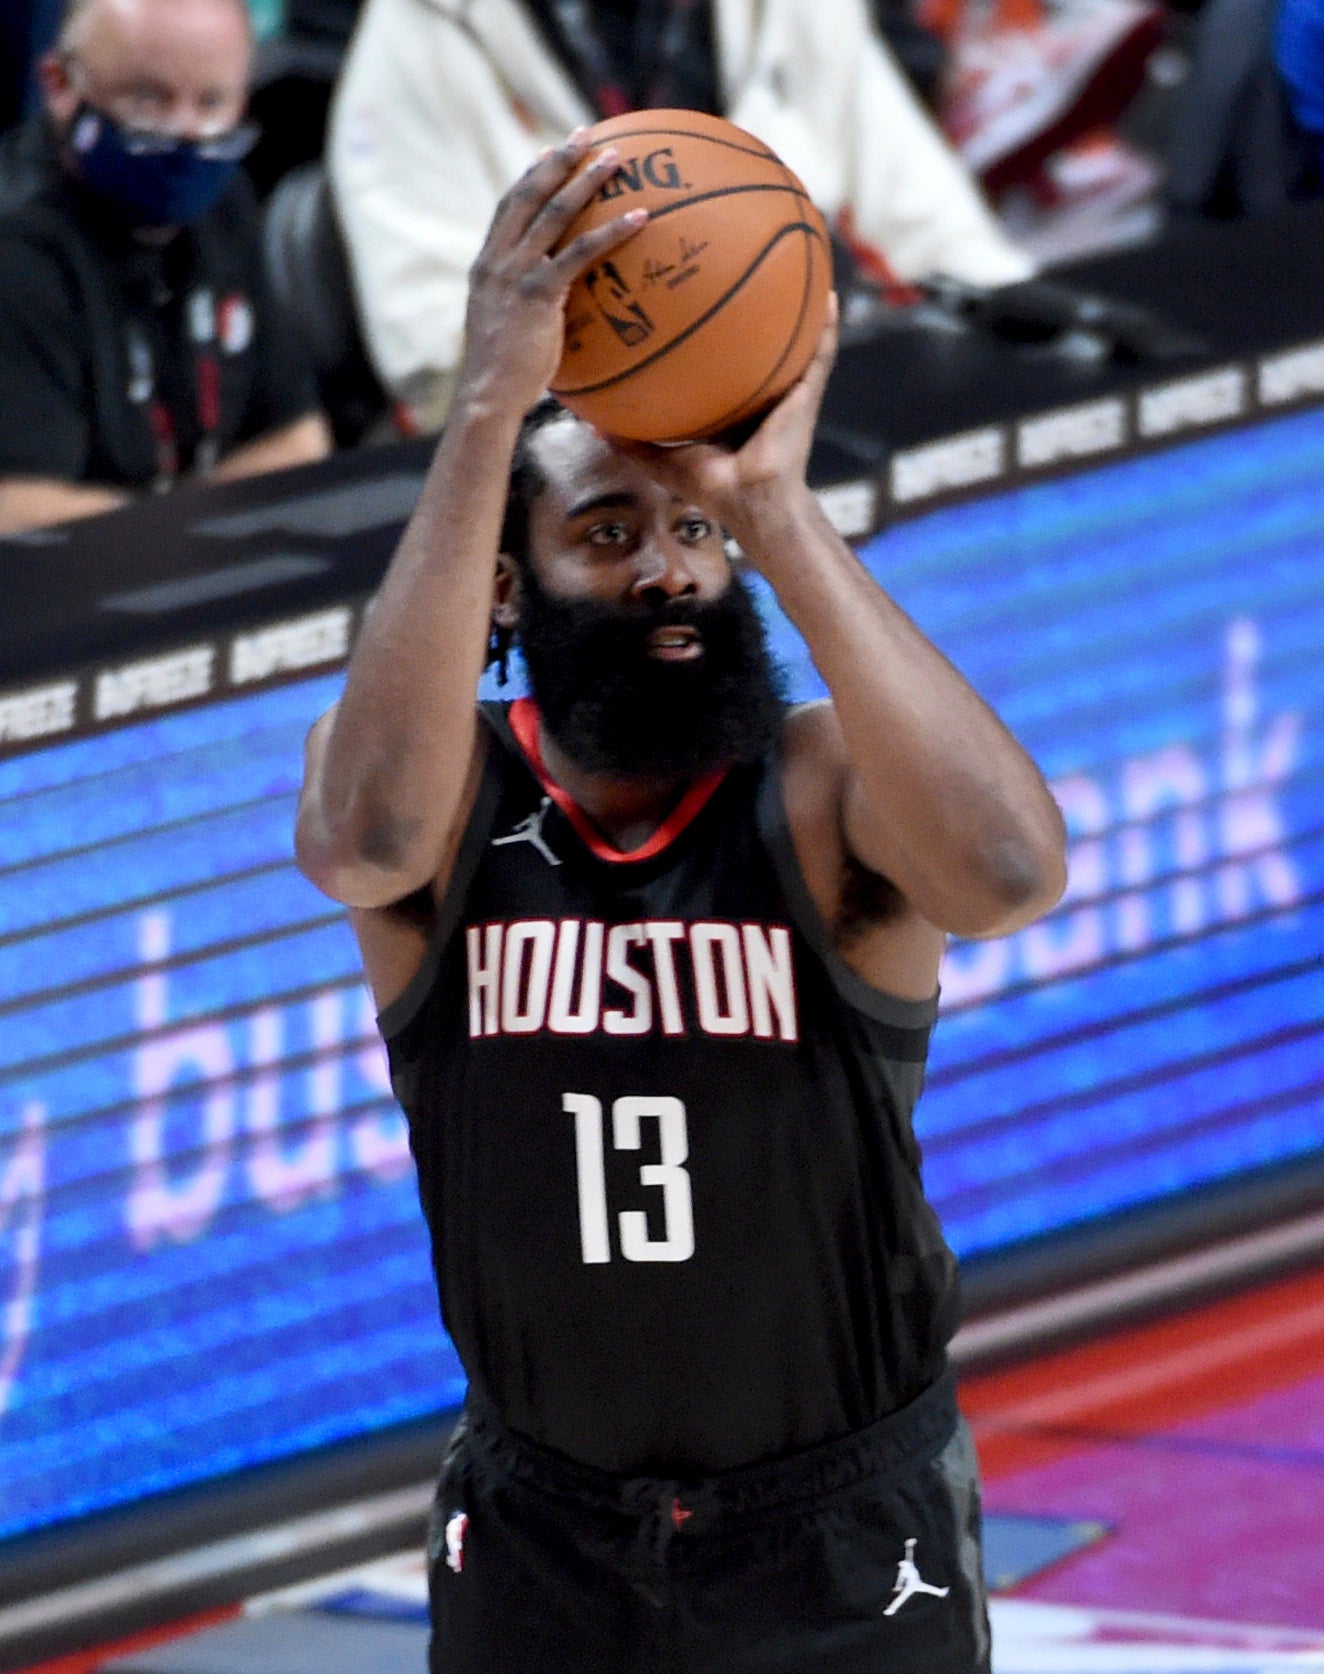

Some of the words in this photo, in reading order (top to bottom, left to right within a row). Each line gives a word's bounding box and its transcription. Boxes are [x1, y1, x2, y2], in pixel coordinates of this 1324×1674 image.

[940, 615, 1304, 1015] ank
[466, 917, 798, 1042] HOUSTON
[562, 1092, 695, 1264] 13
